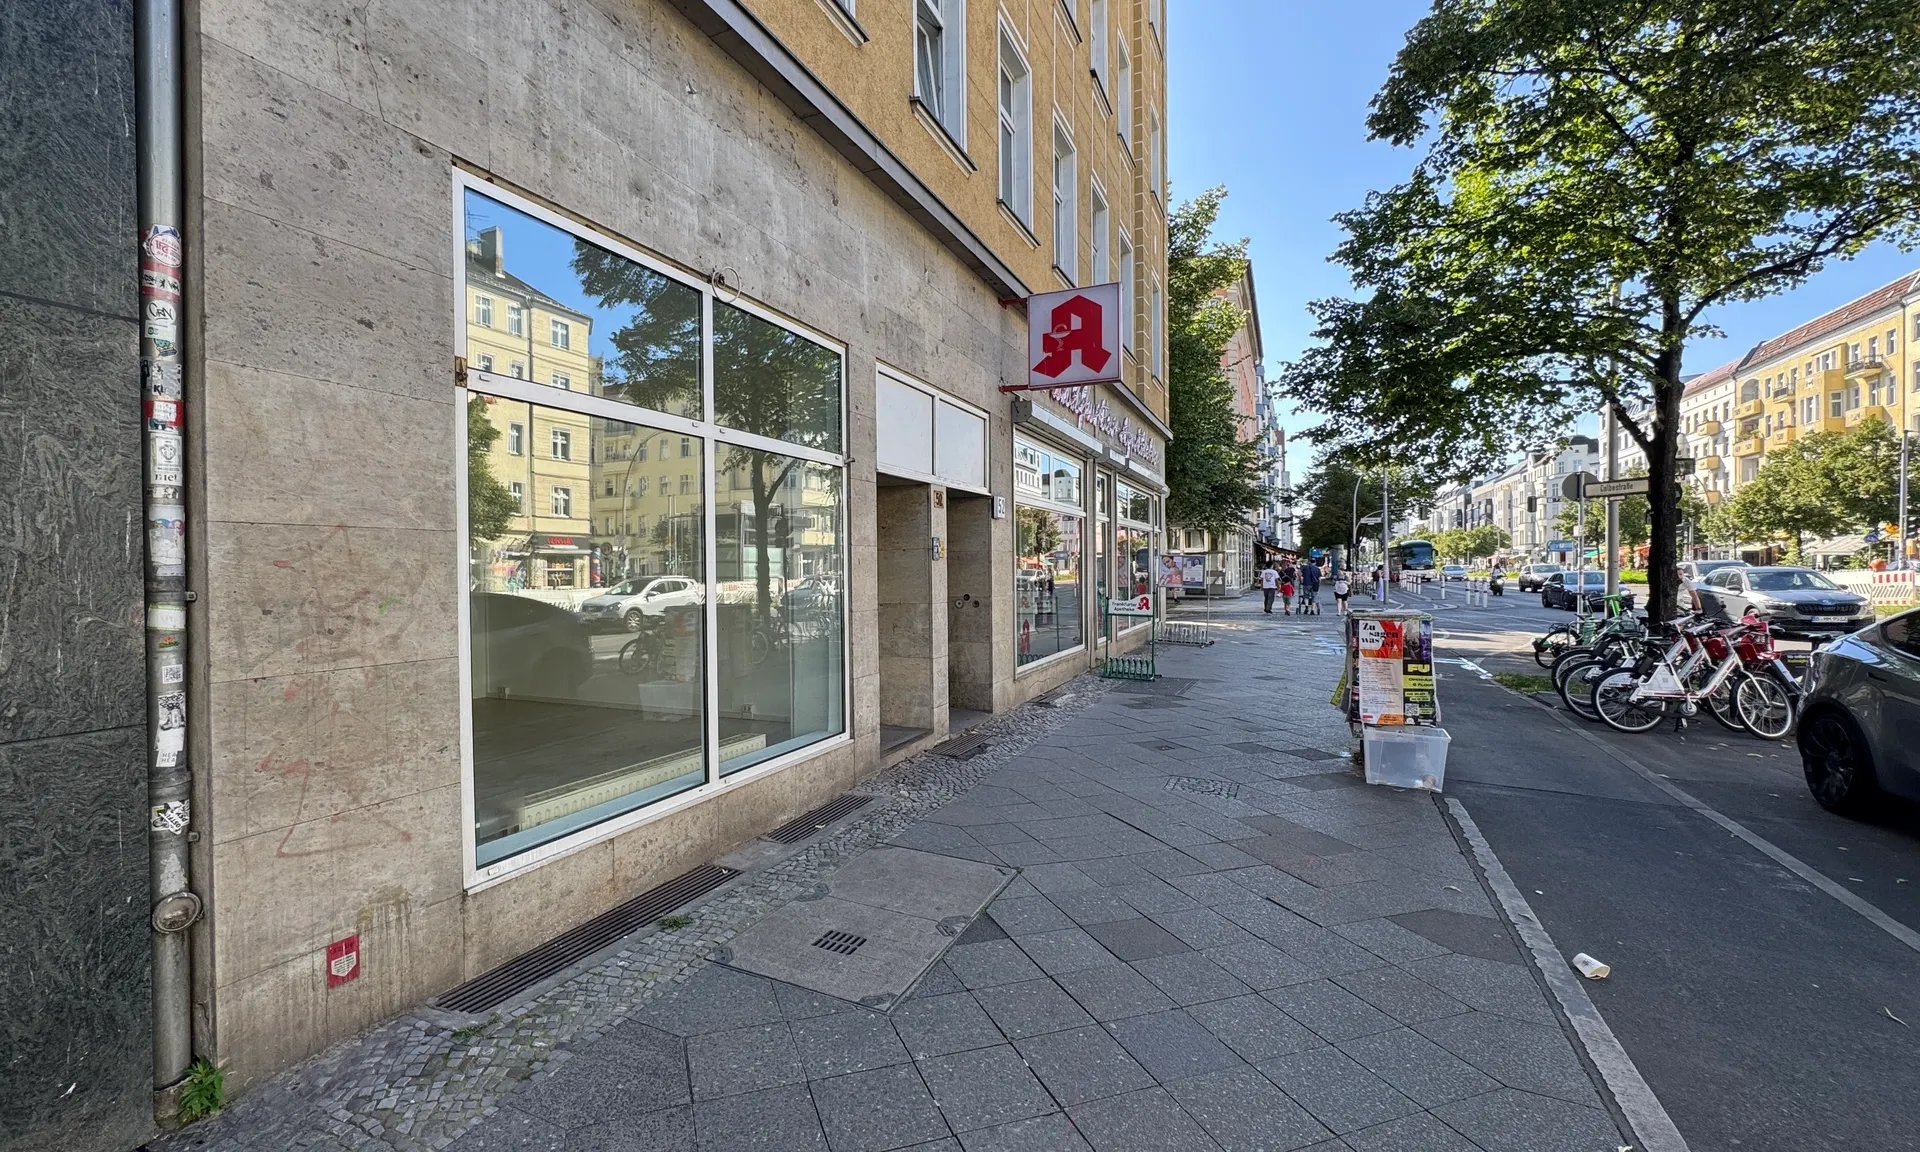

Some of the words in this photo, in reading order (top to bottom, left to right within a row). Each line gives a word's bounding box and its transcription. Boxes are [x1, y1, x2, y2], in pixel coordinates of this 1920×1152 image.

[935, 493, 943, 506] 52
[998, 499, 1005, 514] 52
[1362, 623, 1376, 631] Zu
[1369, 631, 1399, 640] sagen
